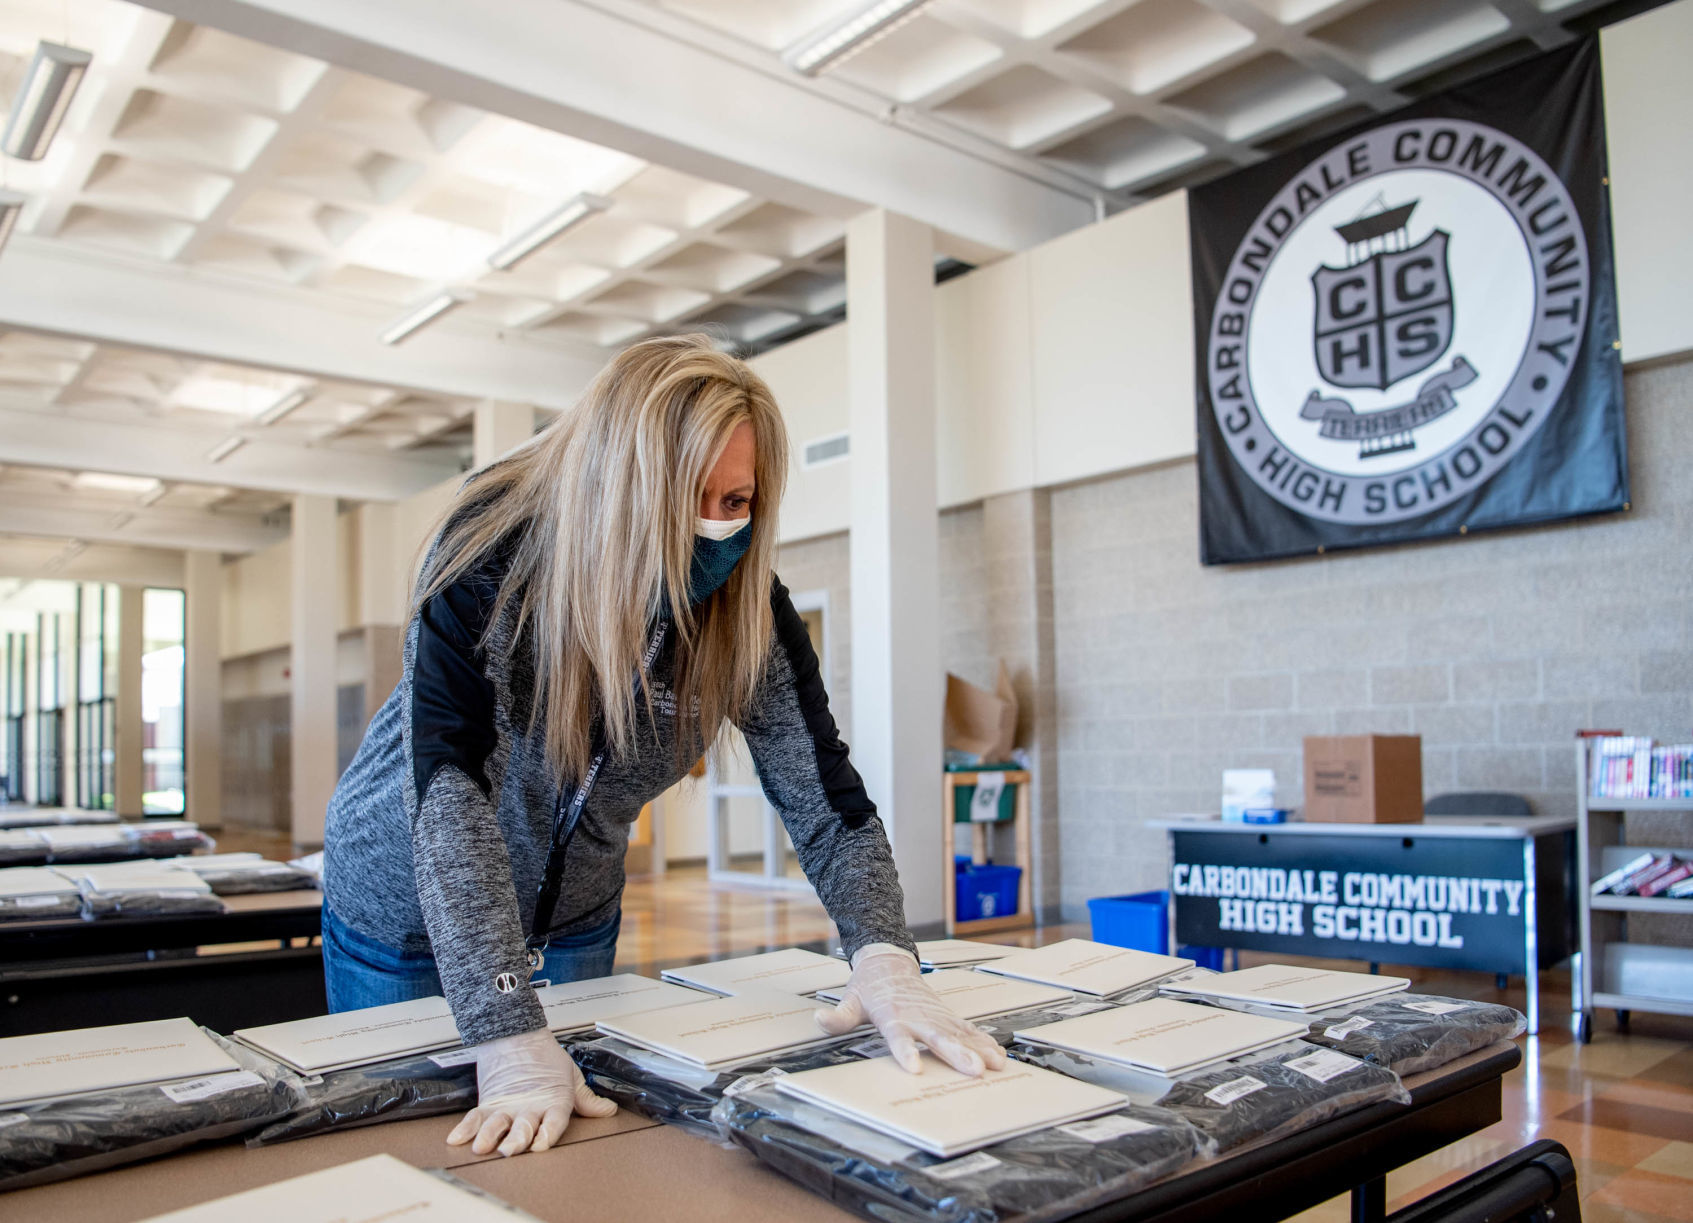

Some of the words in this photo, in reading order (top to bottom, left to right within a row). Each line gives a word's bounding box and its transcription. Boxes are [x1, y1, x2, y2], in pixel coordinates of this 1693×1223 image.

[1218, 143, 1371, 435] CARBONDALE
[1393, 128, 1582, 366] COMMUNITY
[1329, 273, 1368, 322] C
[1395, 255, 1436, 304] C
[1331, 332, 1370, 376] H
[1397, 316, 1440, 359] S
[1258, 448, 1347, 513] HIGH
[1363, 406, 1534, 515] SCHOOL
[574, 764, 600, 807] TERRIERS
[1173, 862, 1338, 905] CARBONDALE
[1343, 872, 1524, 917] COMMUNITY
[1218, 898, 1304, 936] HIGH
[1313, 905, 1464, 950] SCHOOL
